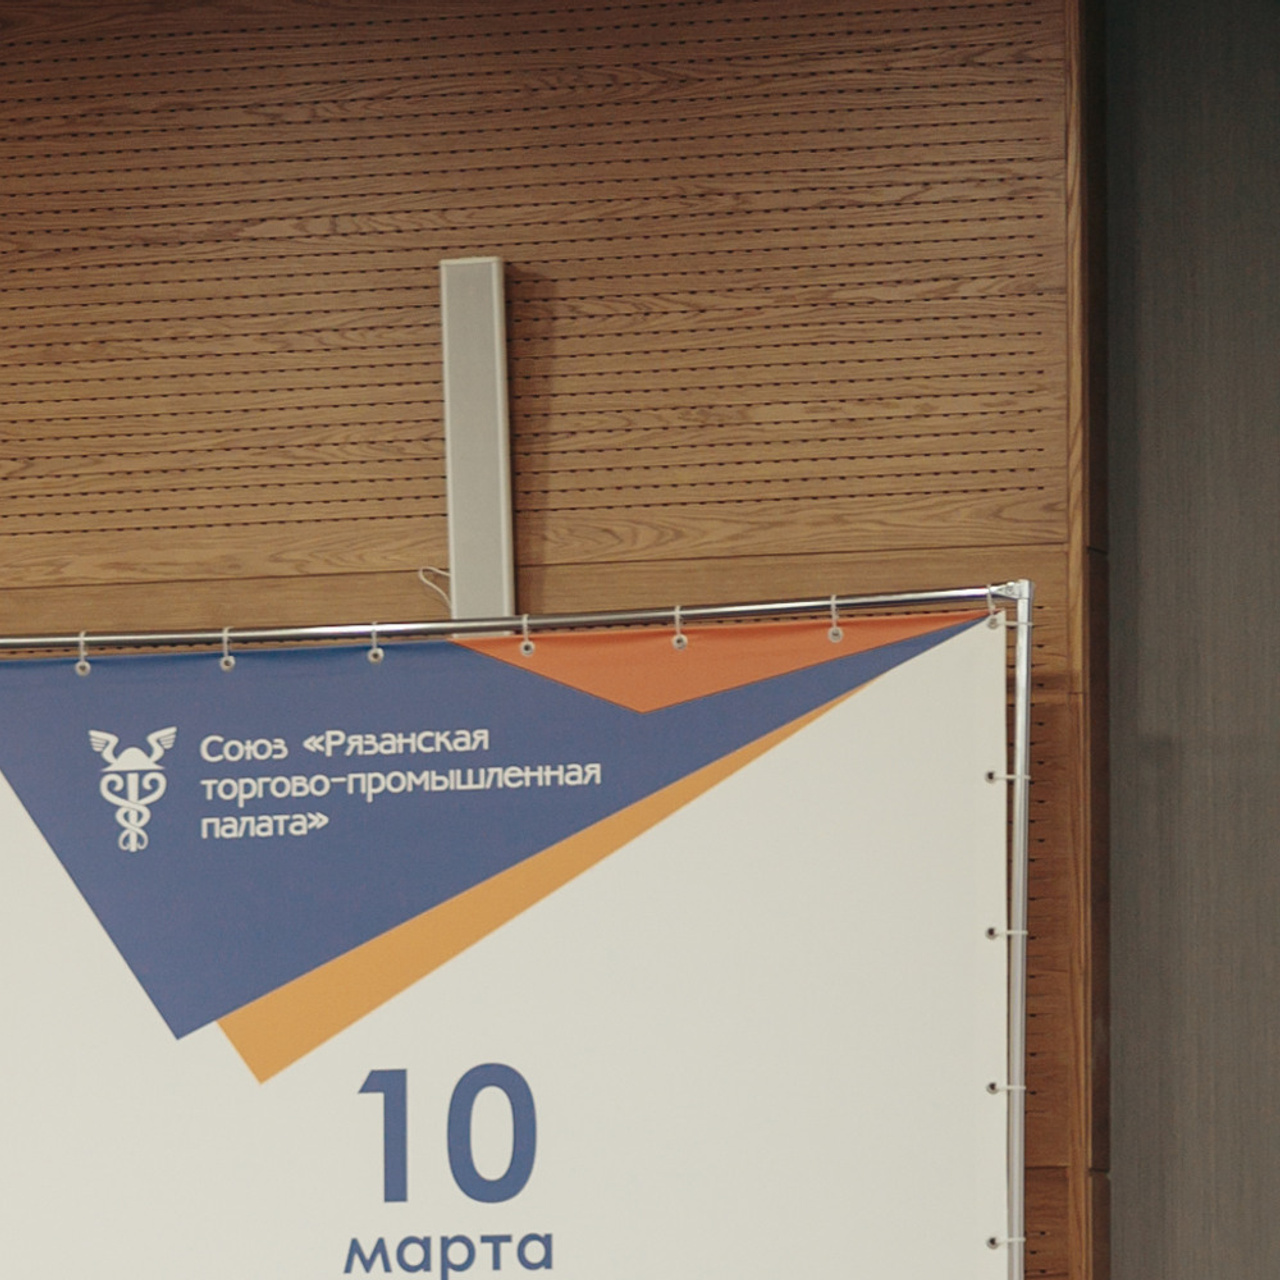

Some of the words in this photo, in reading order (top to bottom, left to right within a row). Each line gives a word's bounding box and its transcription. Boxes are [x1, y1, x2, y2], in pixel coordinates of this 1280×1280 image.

[200, 735, 289, 763] Союз
[303, 728, 490, 758] «Рязанская
[200, 761, 602, 807] торгово-промышленная
[201, 812, 330, 840] палата»
[358, 1063, 538, 1205] 10
